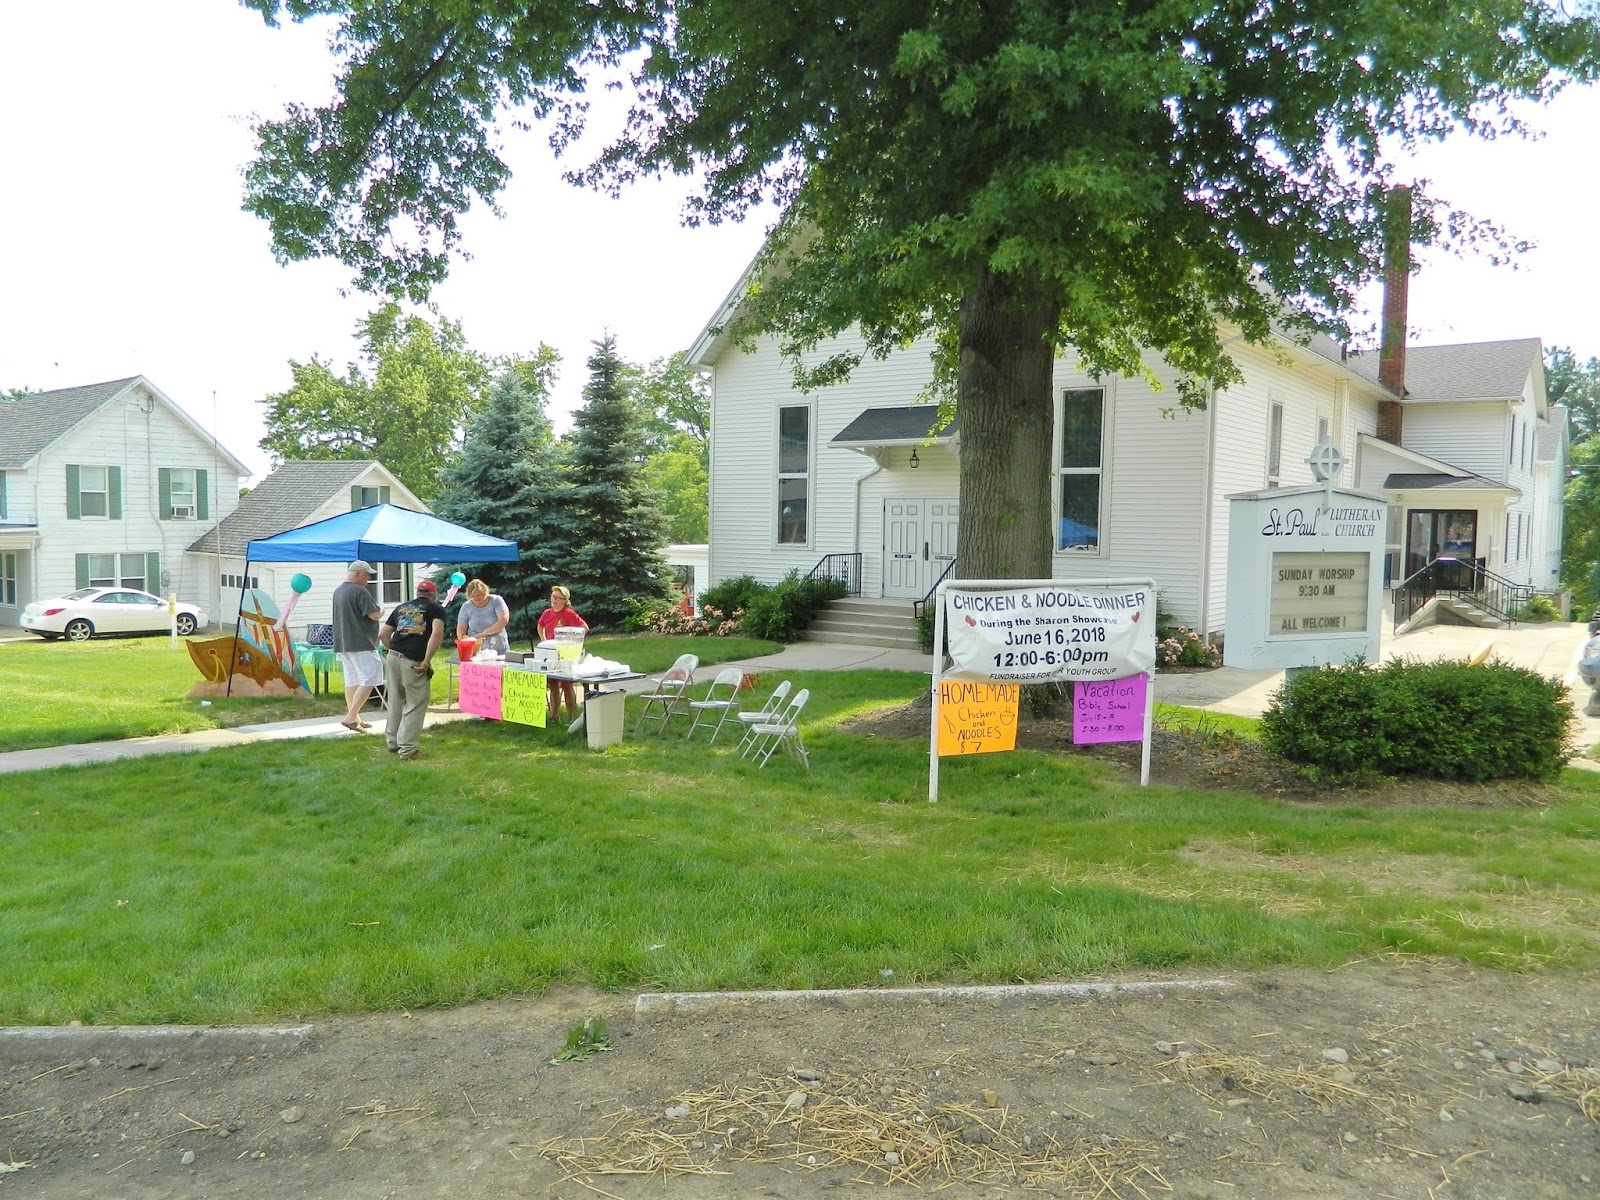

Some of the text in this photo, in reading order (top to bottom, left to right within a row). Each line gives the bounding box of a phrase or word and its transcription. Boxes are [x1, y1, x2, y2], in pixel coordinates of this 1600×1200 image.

[1330, 508, 1382, 521] LUTHERAN
[1262, 508, 1320, 536] St. Paul
[1335, 524, 1375, 537] CHURCH
[1279, 568, 1355, 582] SUNDAY WORSHIP
[1298, 585, 1336, 596] 9:30 AM
[953, 592, 1145, 612] CHICKEN & NOODLE DINNER
[980, 615, 1118, 628] During the Sharon Showcase
[1282, 619, 1298, 630] ALL
[1004, 631, 1041, 646] June
[1066, 668, 1090, 676] YOUTH
[503, 669, 545, 689] HOMEMADE
[942, 683, 1017, 705] HOMEMADE
[1081, 680, 1134, 697] Vacation
[519, 700, 543, 710] NOODLES
[1078, 699, 1130, 710] Bible School
[959, 707, 996, 721] Chicken
[973, 719, 986, 727] and
[958, 726, 1001, 741] NOODLES
